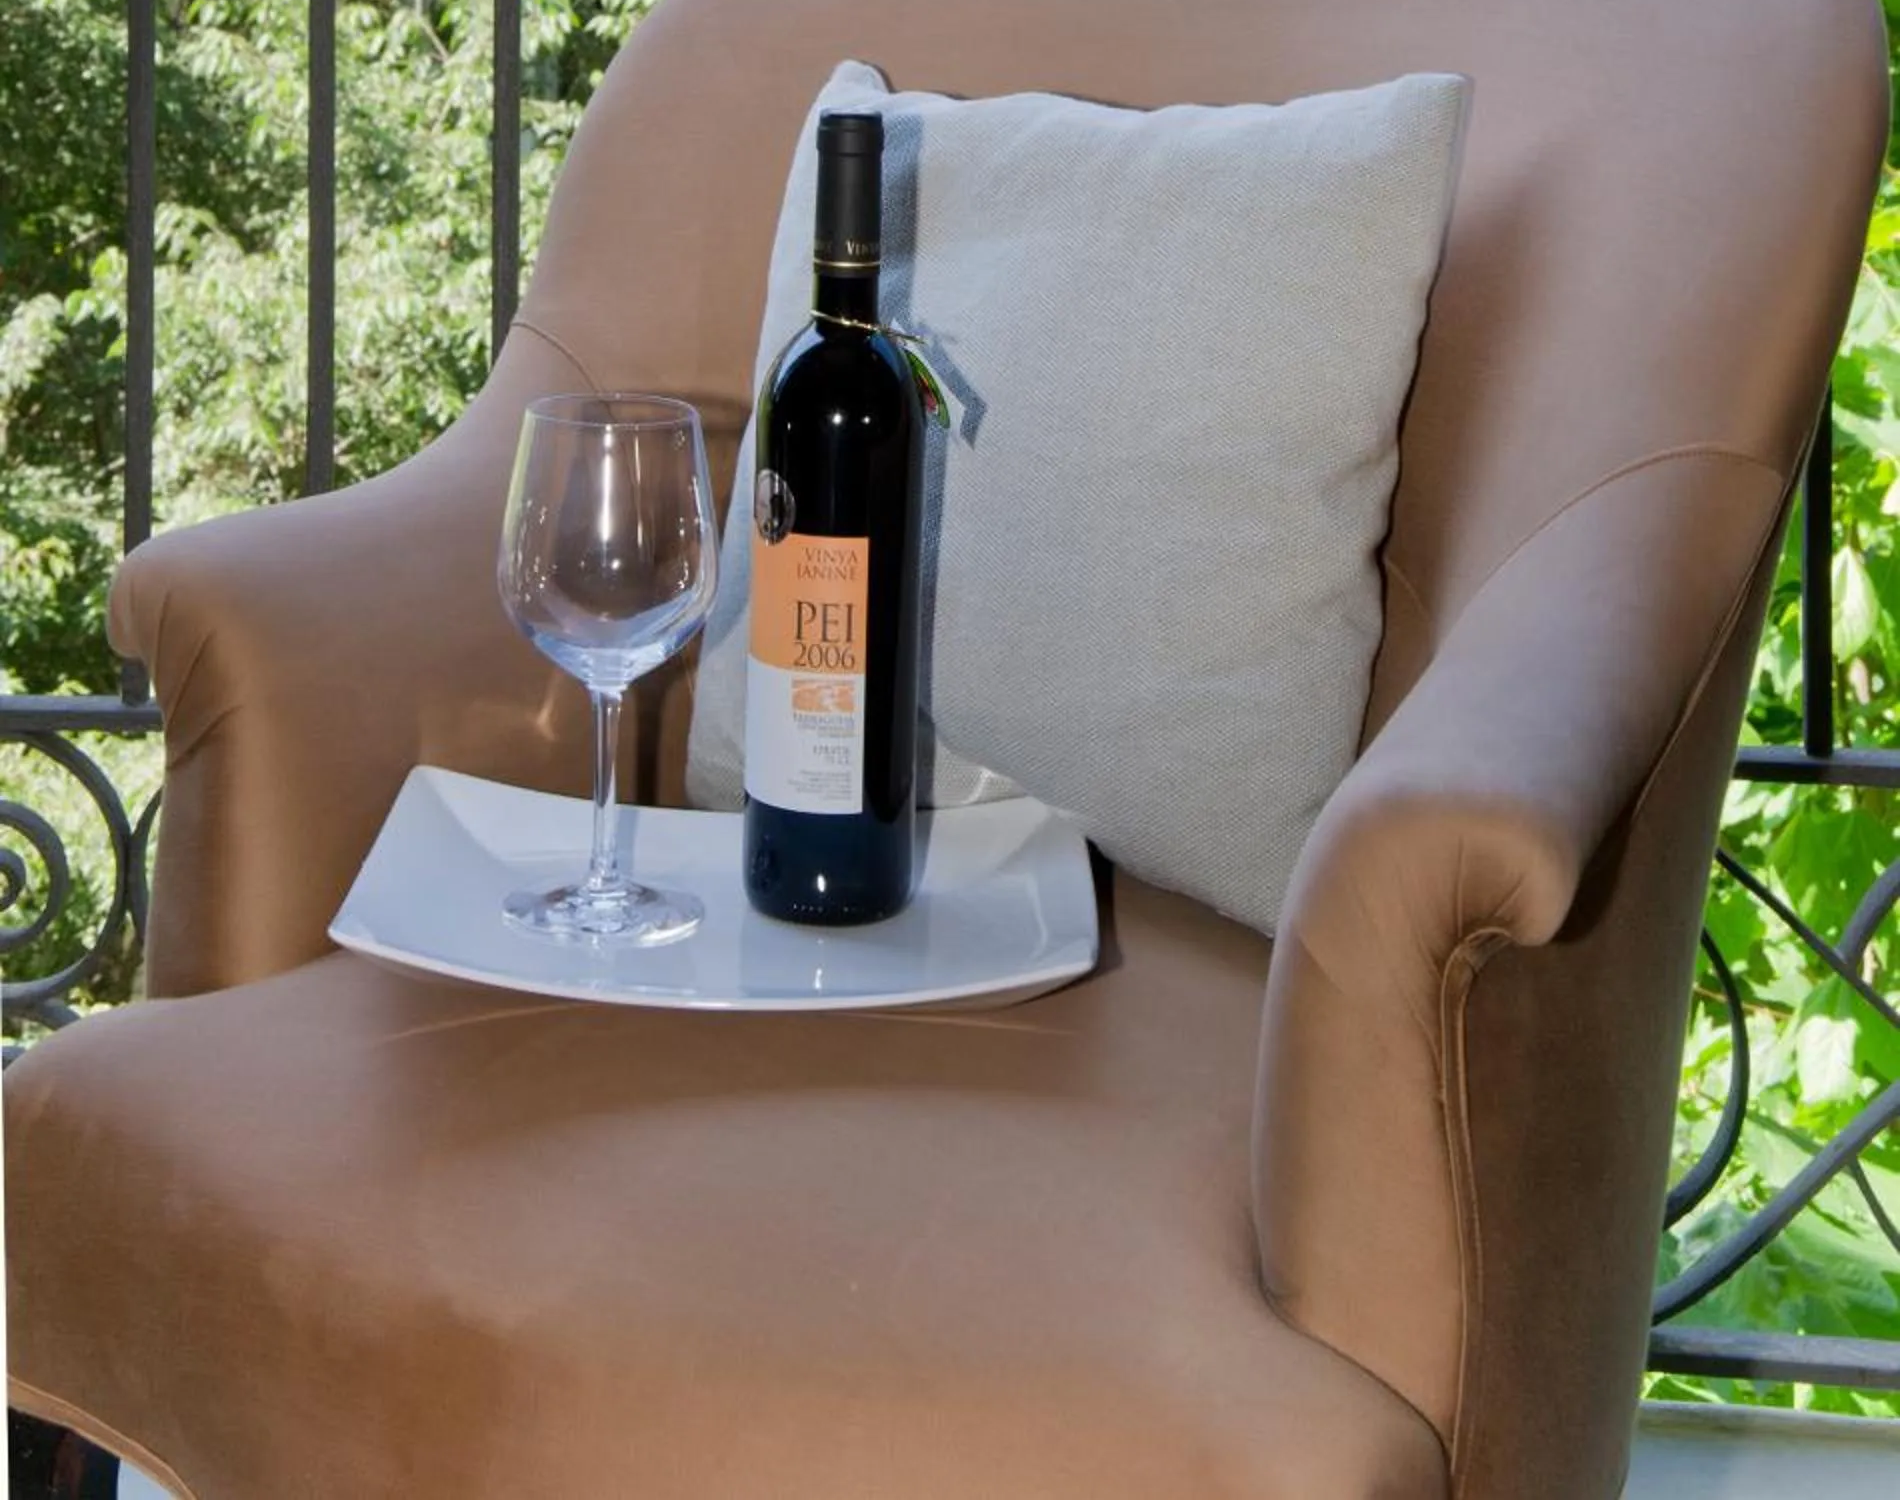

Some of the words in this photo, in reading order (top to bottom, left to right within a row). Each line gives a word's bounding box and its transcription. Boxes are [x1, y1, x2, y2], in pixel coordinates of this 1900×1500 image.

[801, 547, 859, 565] VINYA
[795, 600, 854, 643] PEI
[793, 642, 856, 670] 2006
